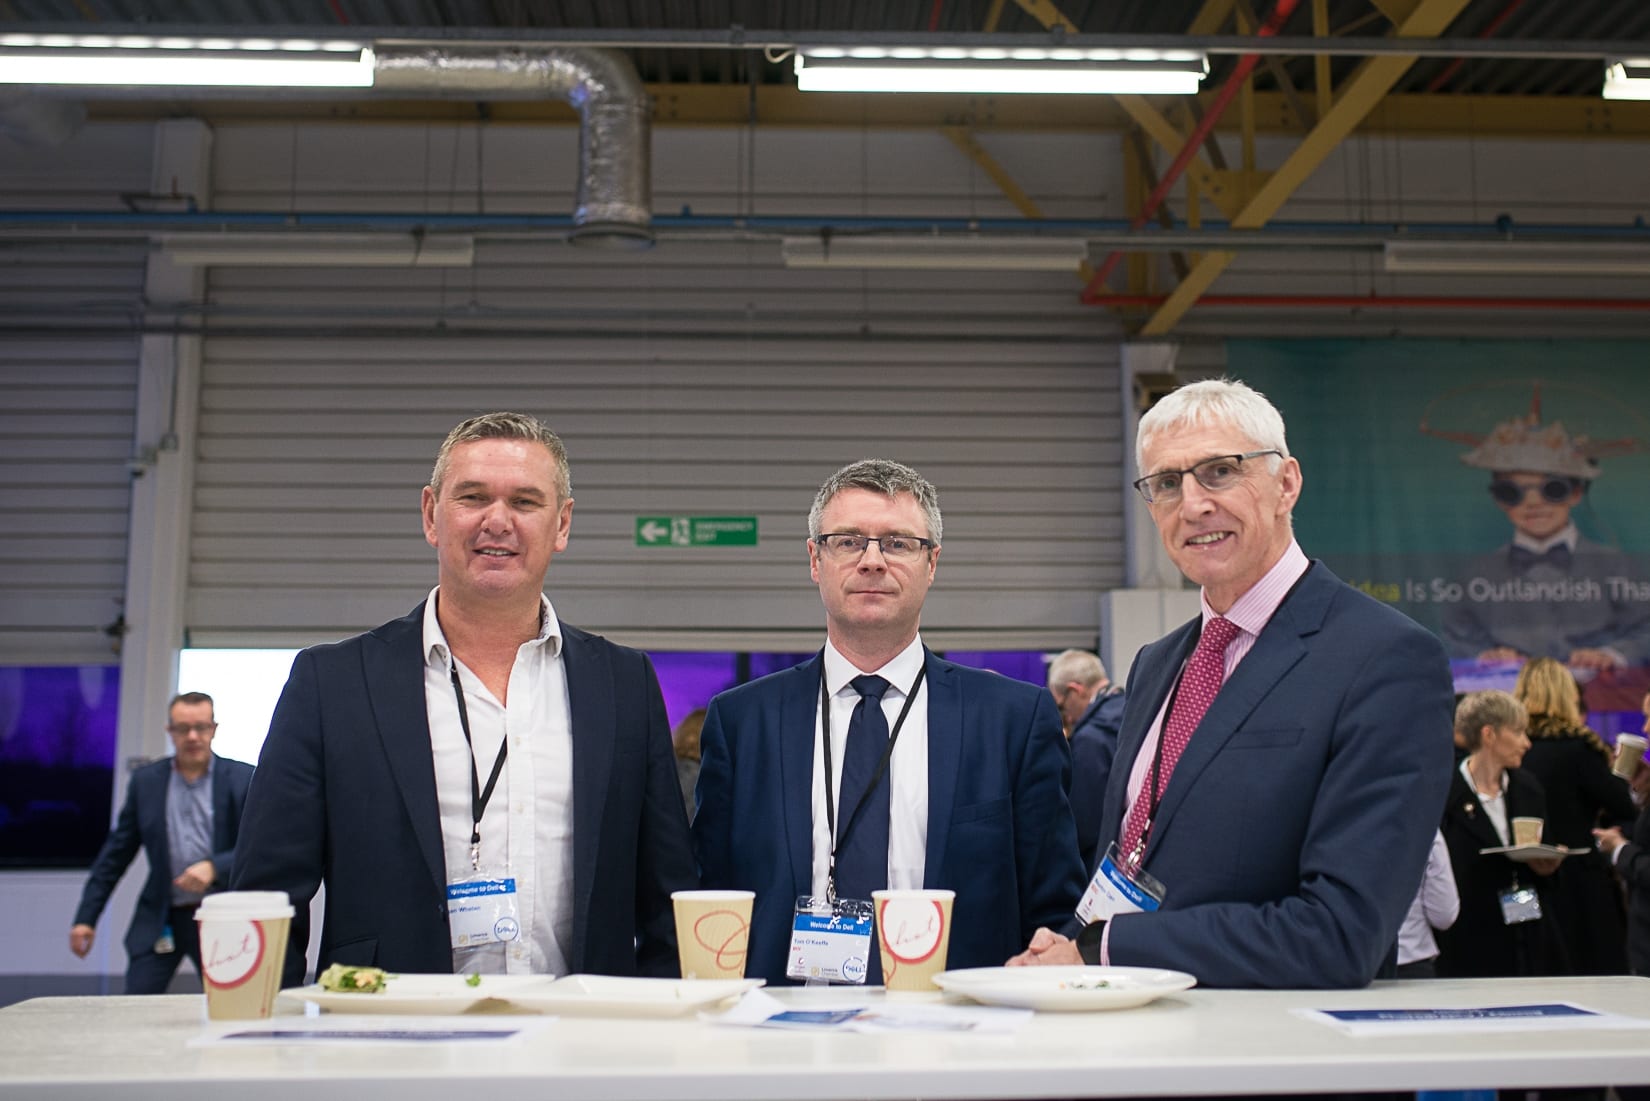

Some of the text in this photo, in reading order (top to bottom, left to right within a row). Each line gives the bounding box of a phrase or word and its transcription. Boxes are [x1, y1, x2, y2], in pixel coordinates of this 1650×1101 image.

[1405, 579, 1426, 601] Is
[1432, 578, 1463, 602] So
[1468, 576, 1601, 602] Outlandish
